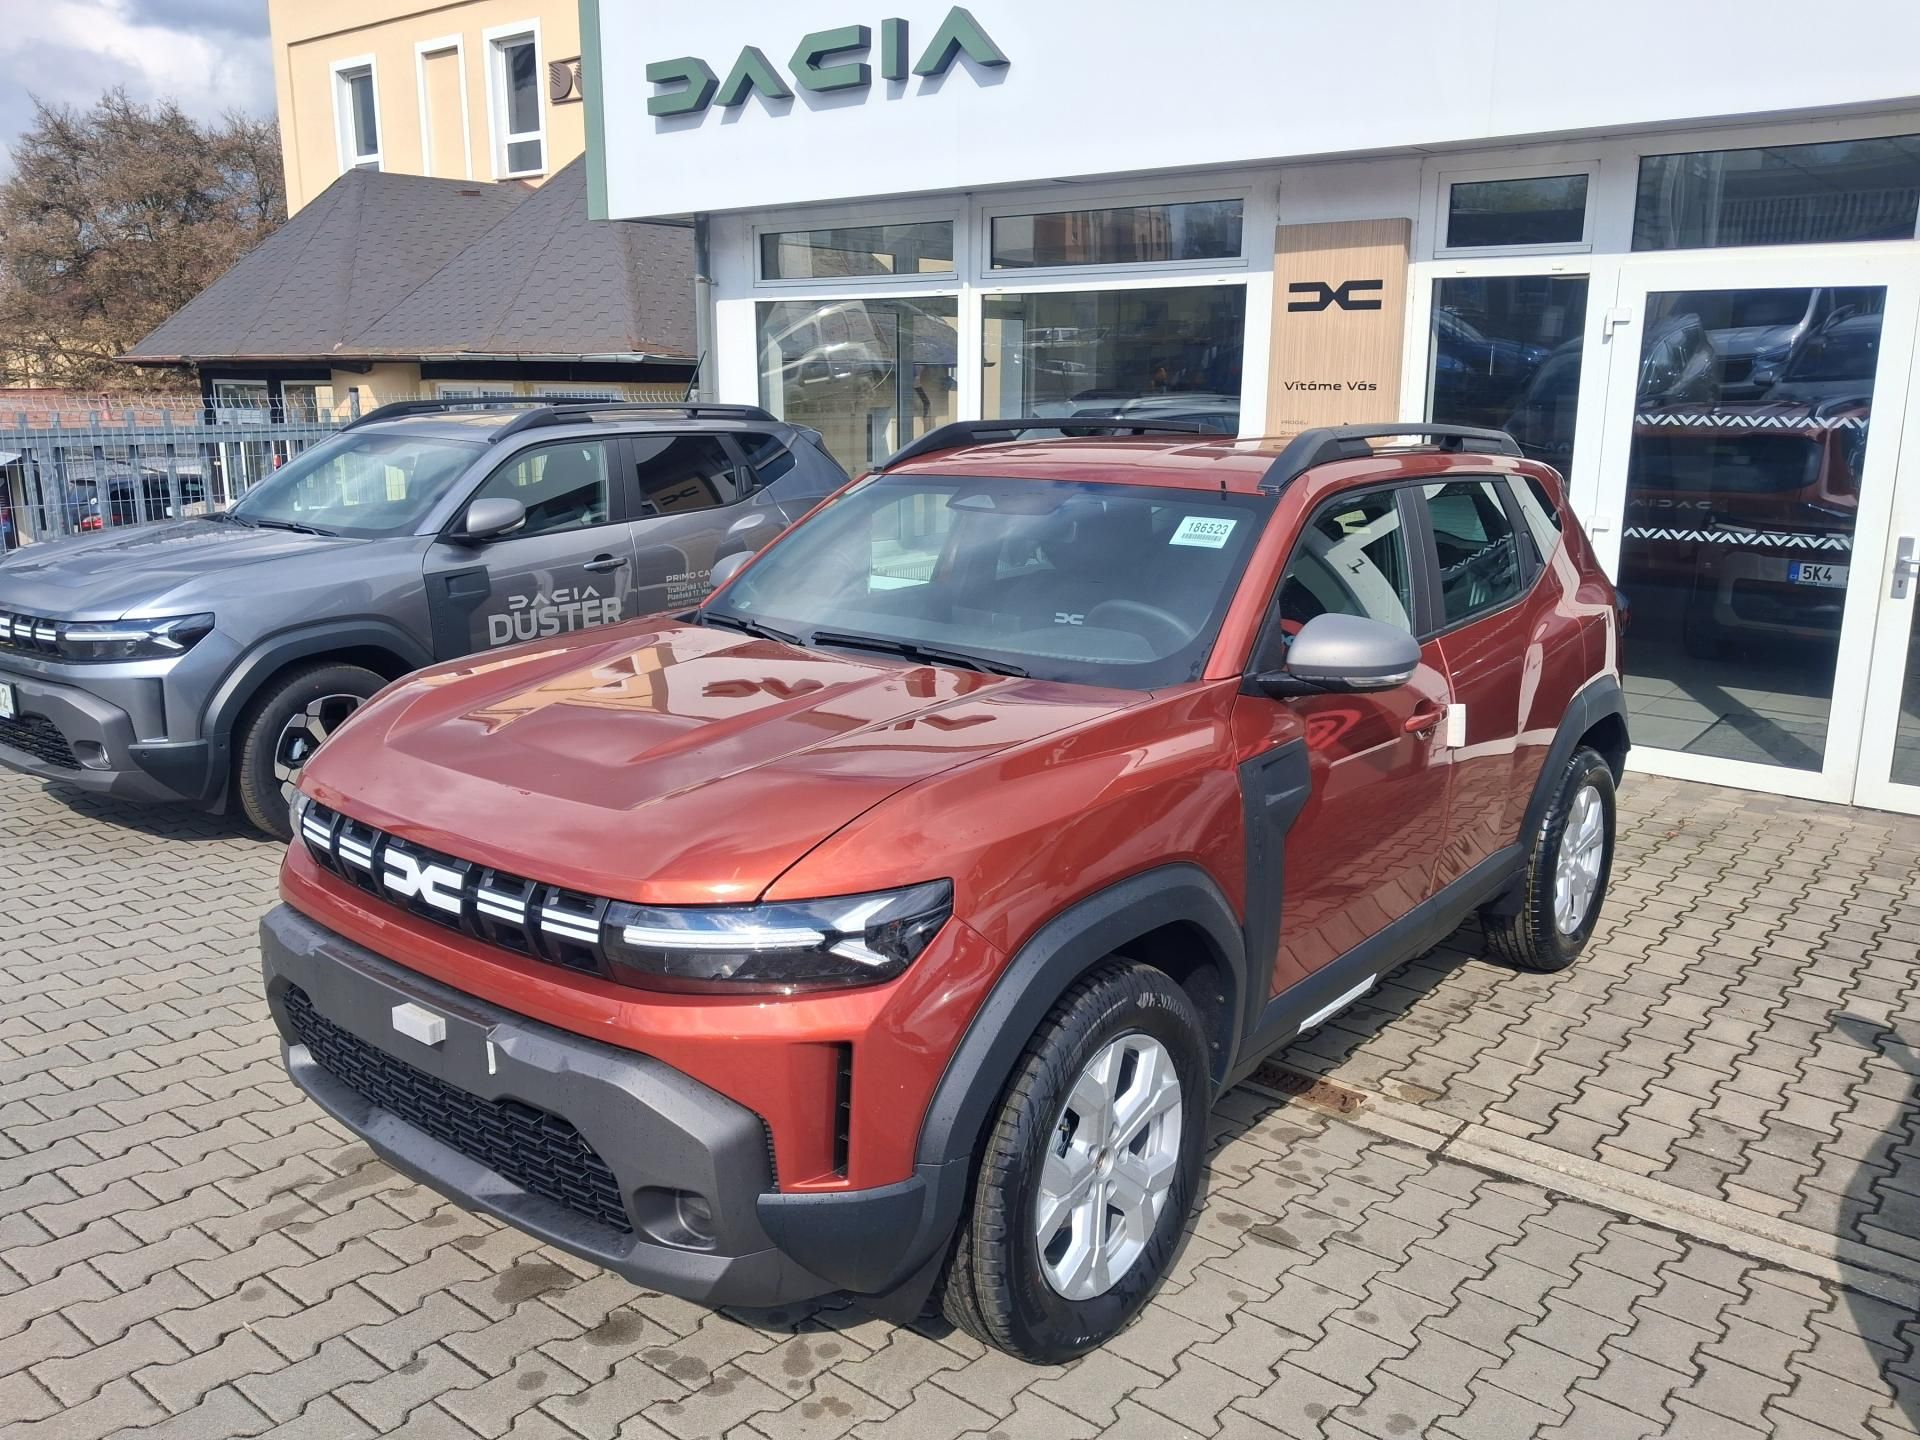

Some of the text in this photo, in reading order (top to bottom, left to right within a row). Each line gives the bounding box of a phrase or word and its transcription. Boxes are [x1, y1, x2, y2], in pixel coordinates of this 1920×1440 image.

[646, 5, 1011, 117] DACIA
[1284, 380, 1377, 391] Vítáme Vás
[1188, 522, 1229, 535] 186523
[666, 572, 696, 582] PRIMO
[1802, 565, 1833, 582] 5K4
[508, 585, 600, 610] DACIA
[488, 596, 622, 646] DUSTER
